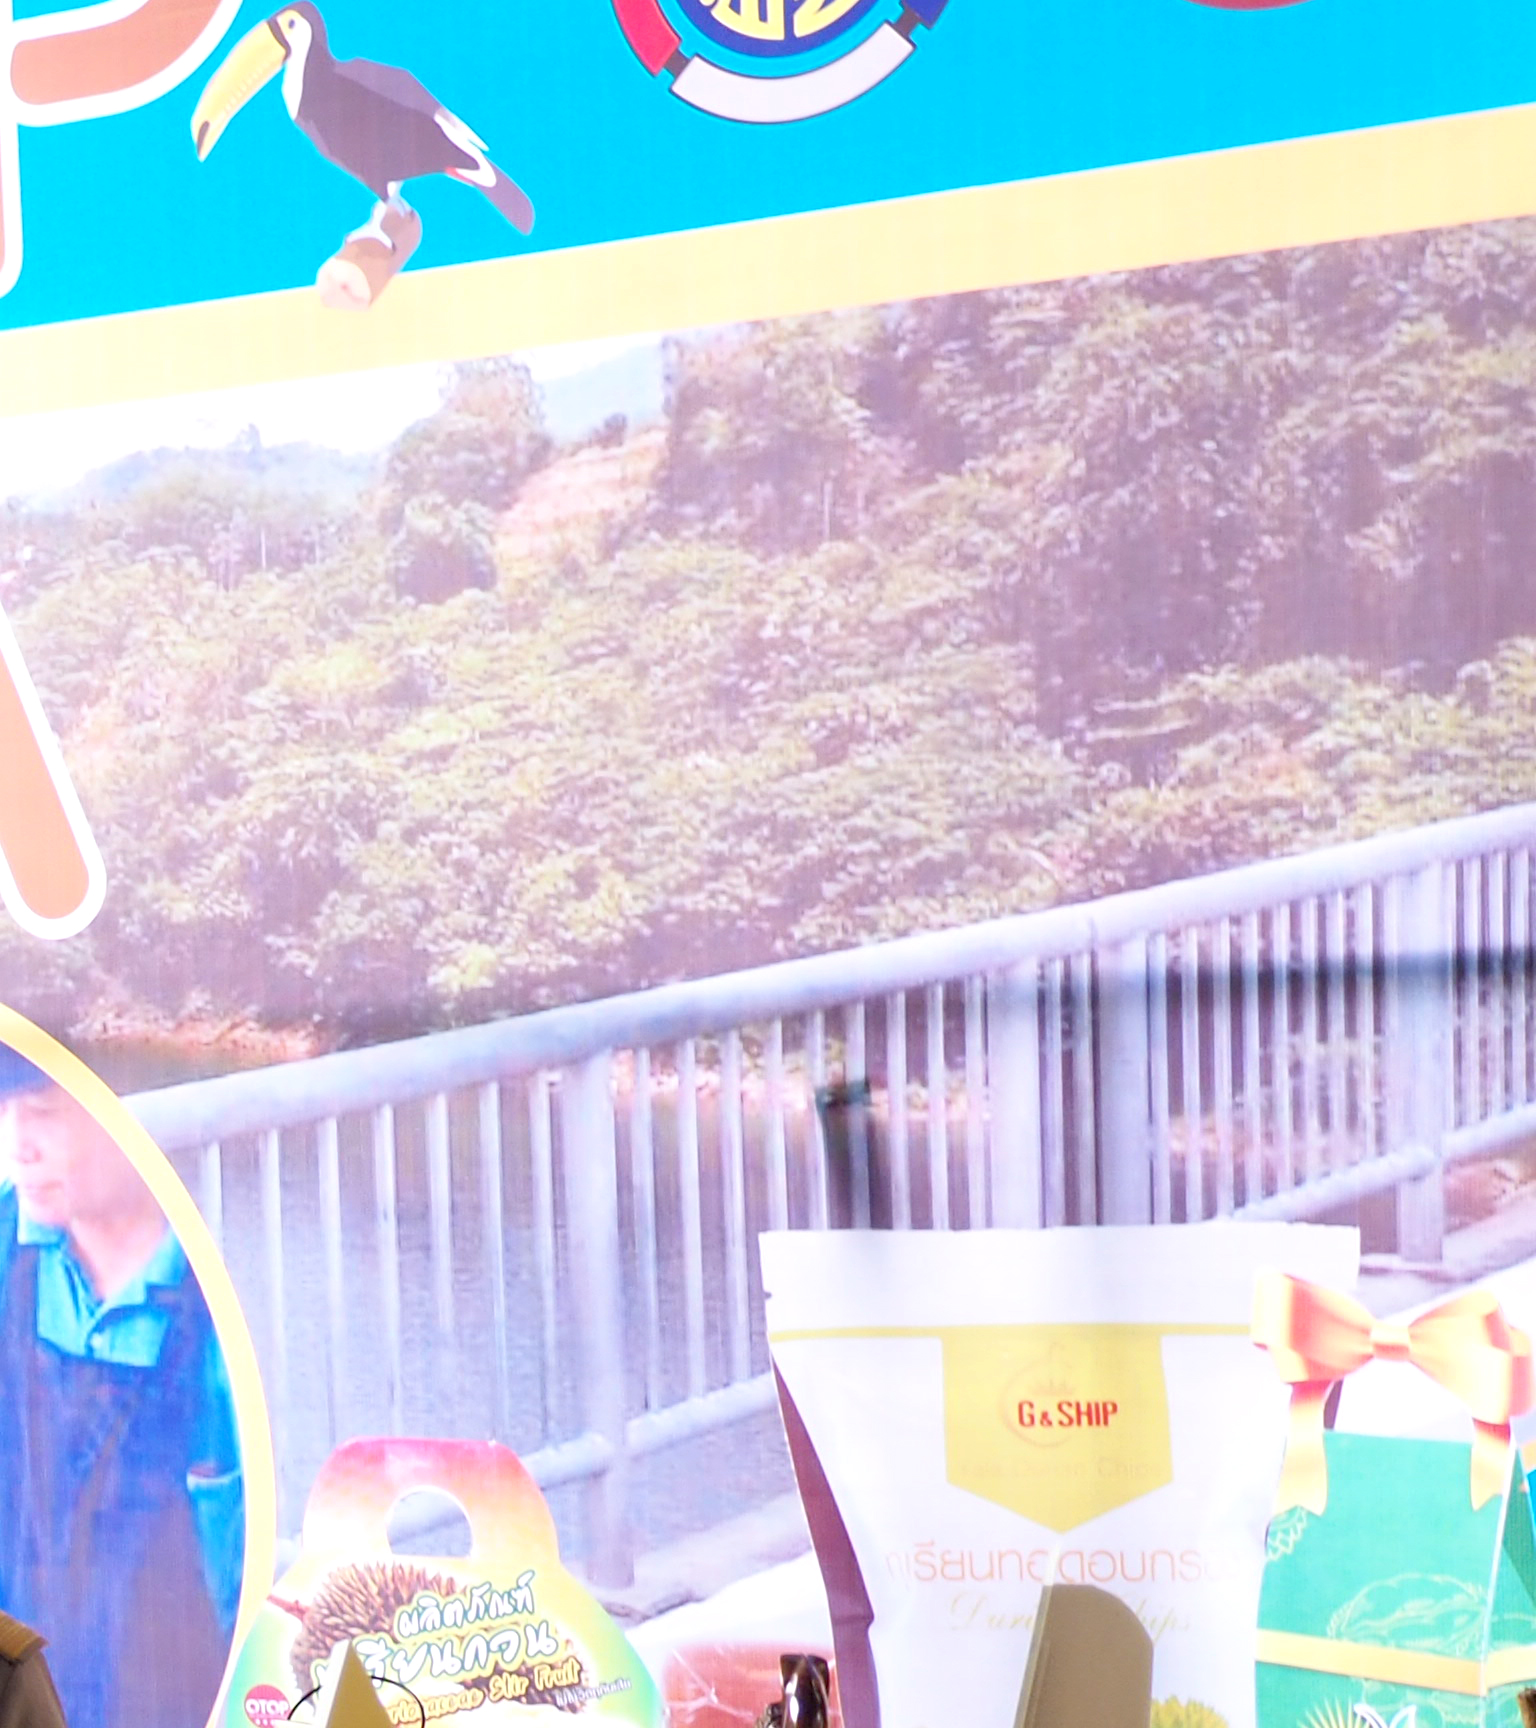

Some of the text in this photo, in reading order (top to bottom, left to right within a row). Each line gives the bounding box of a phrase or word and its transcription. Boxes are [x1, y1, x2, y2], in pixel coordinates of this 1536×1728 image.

[1017, 1400, 1119, 1428] G & SHIP
[245, 1698, 289, 1716] OTOP
